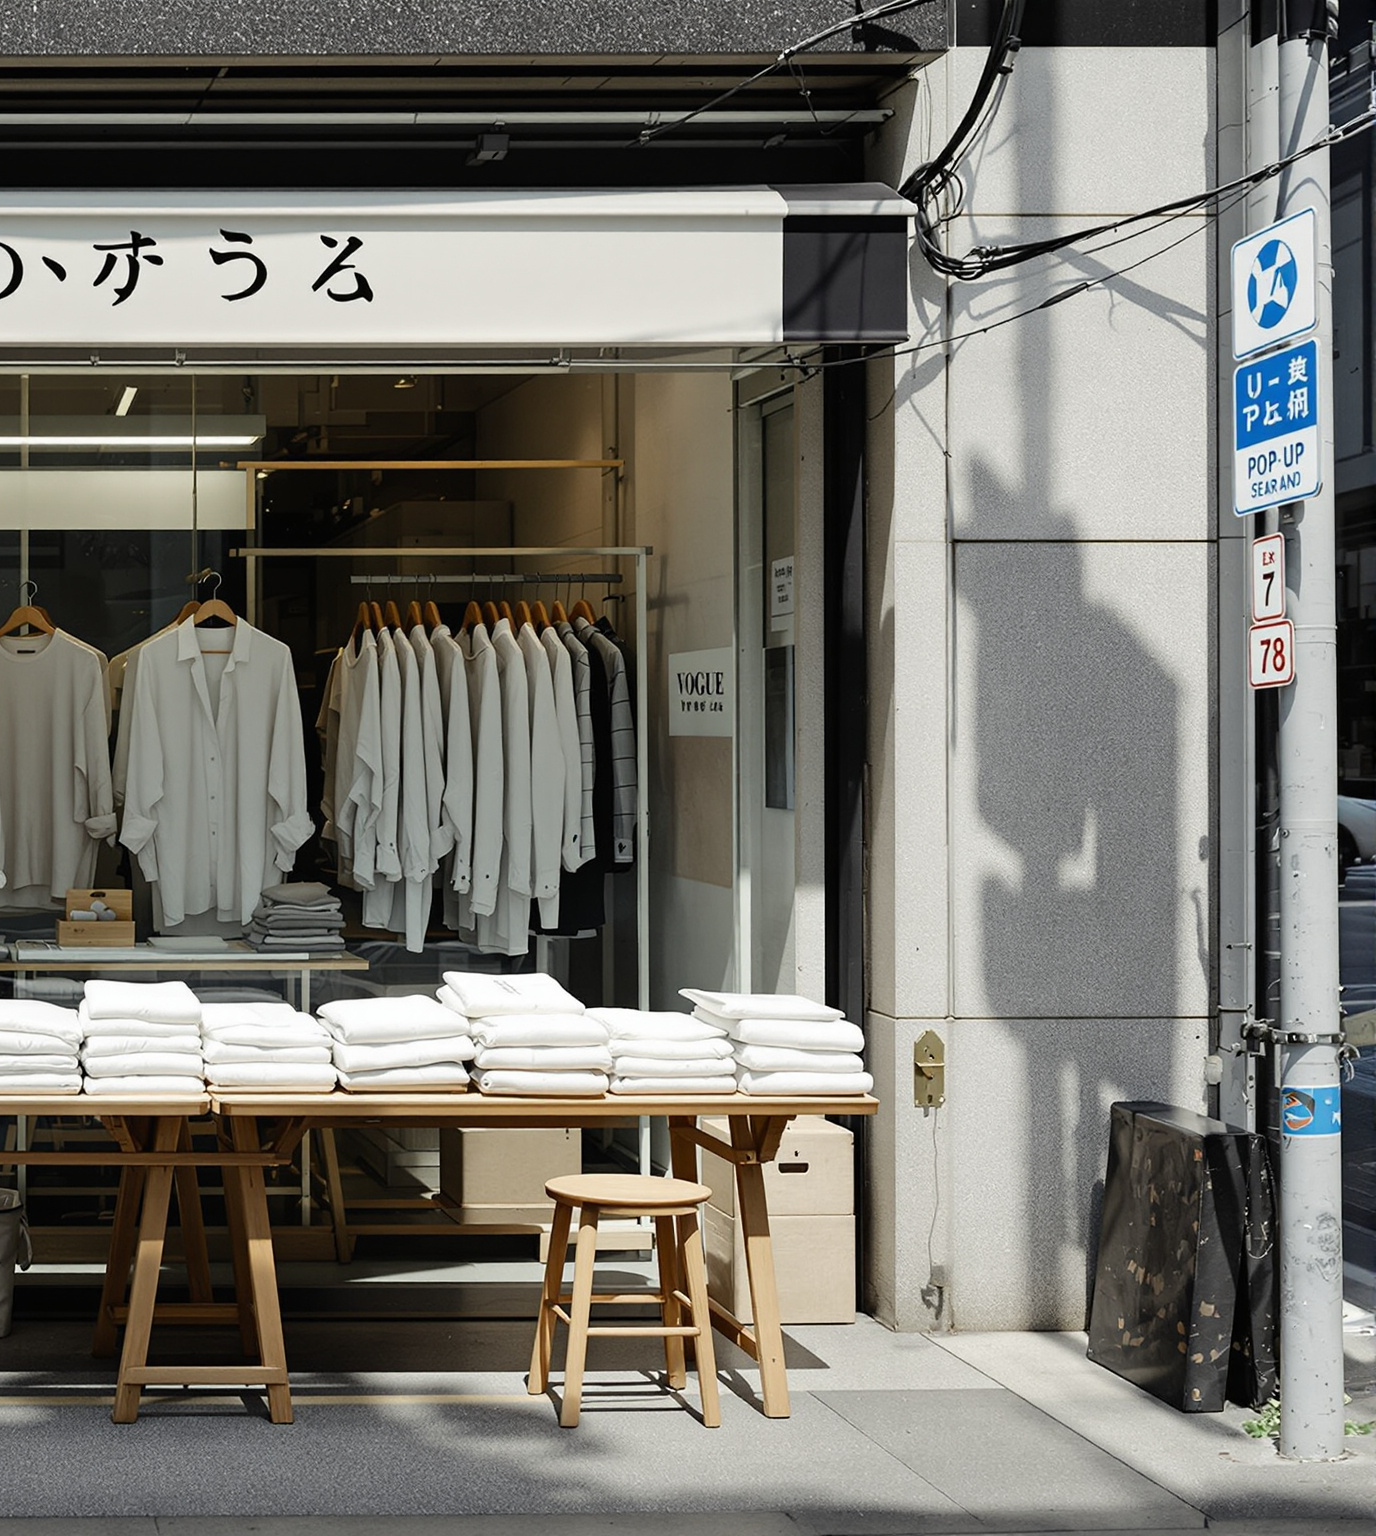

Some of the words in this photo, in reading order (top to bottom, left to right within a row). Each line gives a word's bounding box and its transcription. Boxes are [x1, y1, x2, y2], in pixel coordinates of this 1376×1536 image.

[1262, 571, 1276, 607] 7
[1260, 637, 1286, 674] 78
[676, 671, 724, 696] VOGUE
